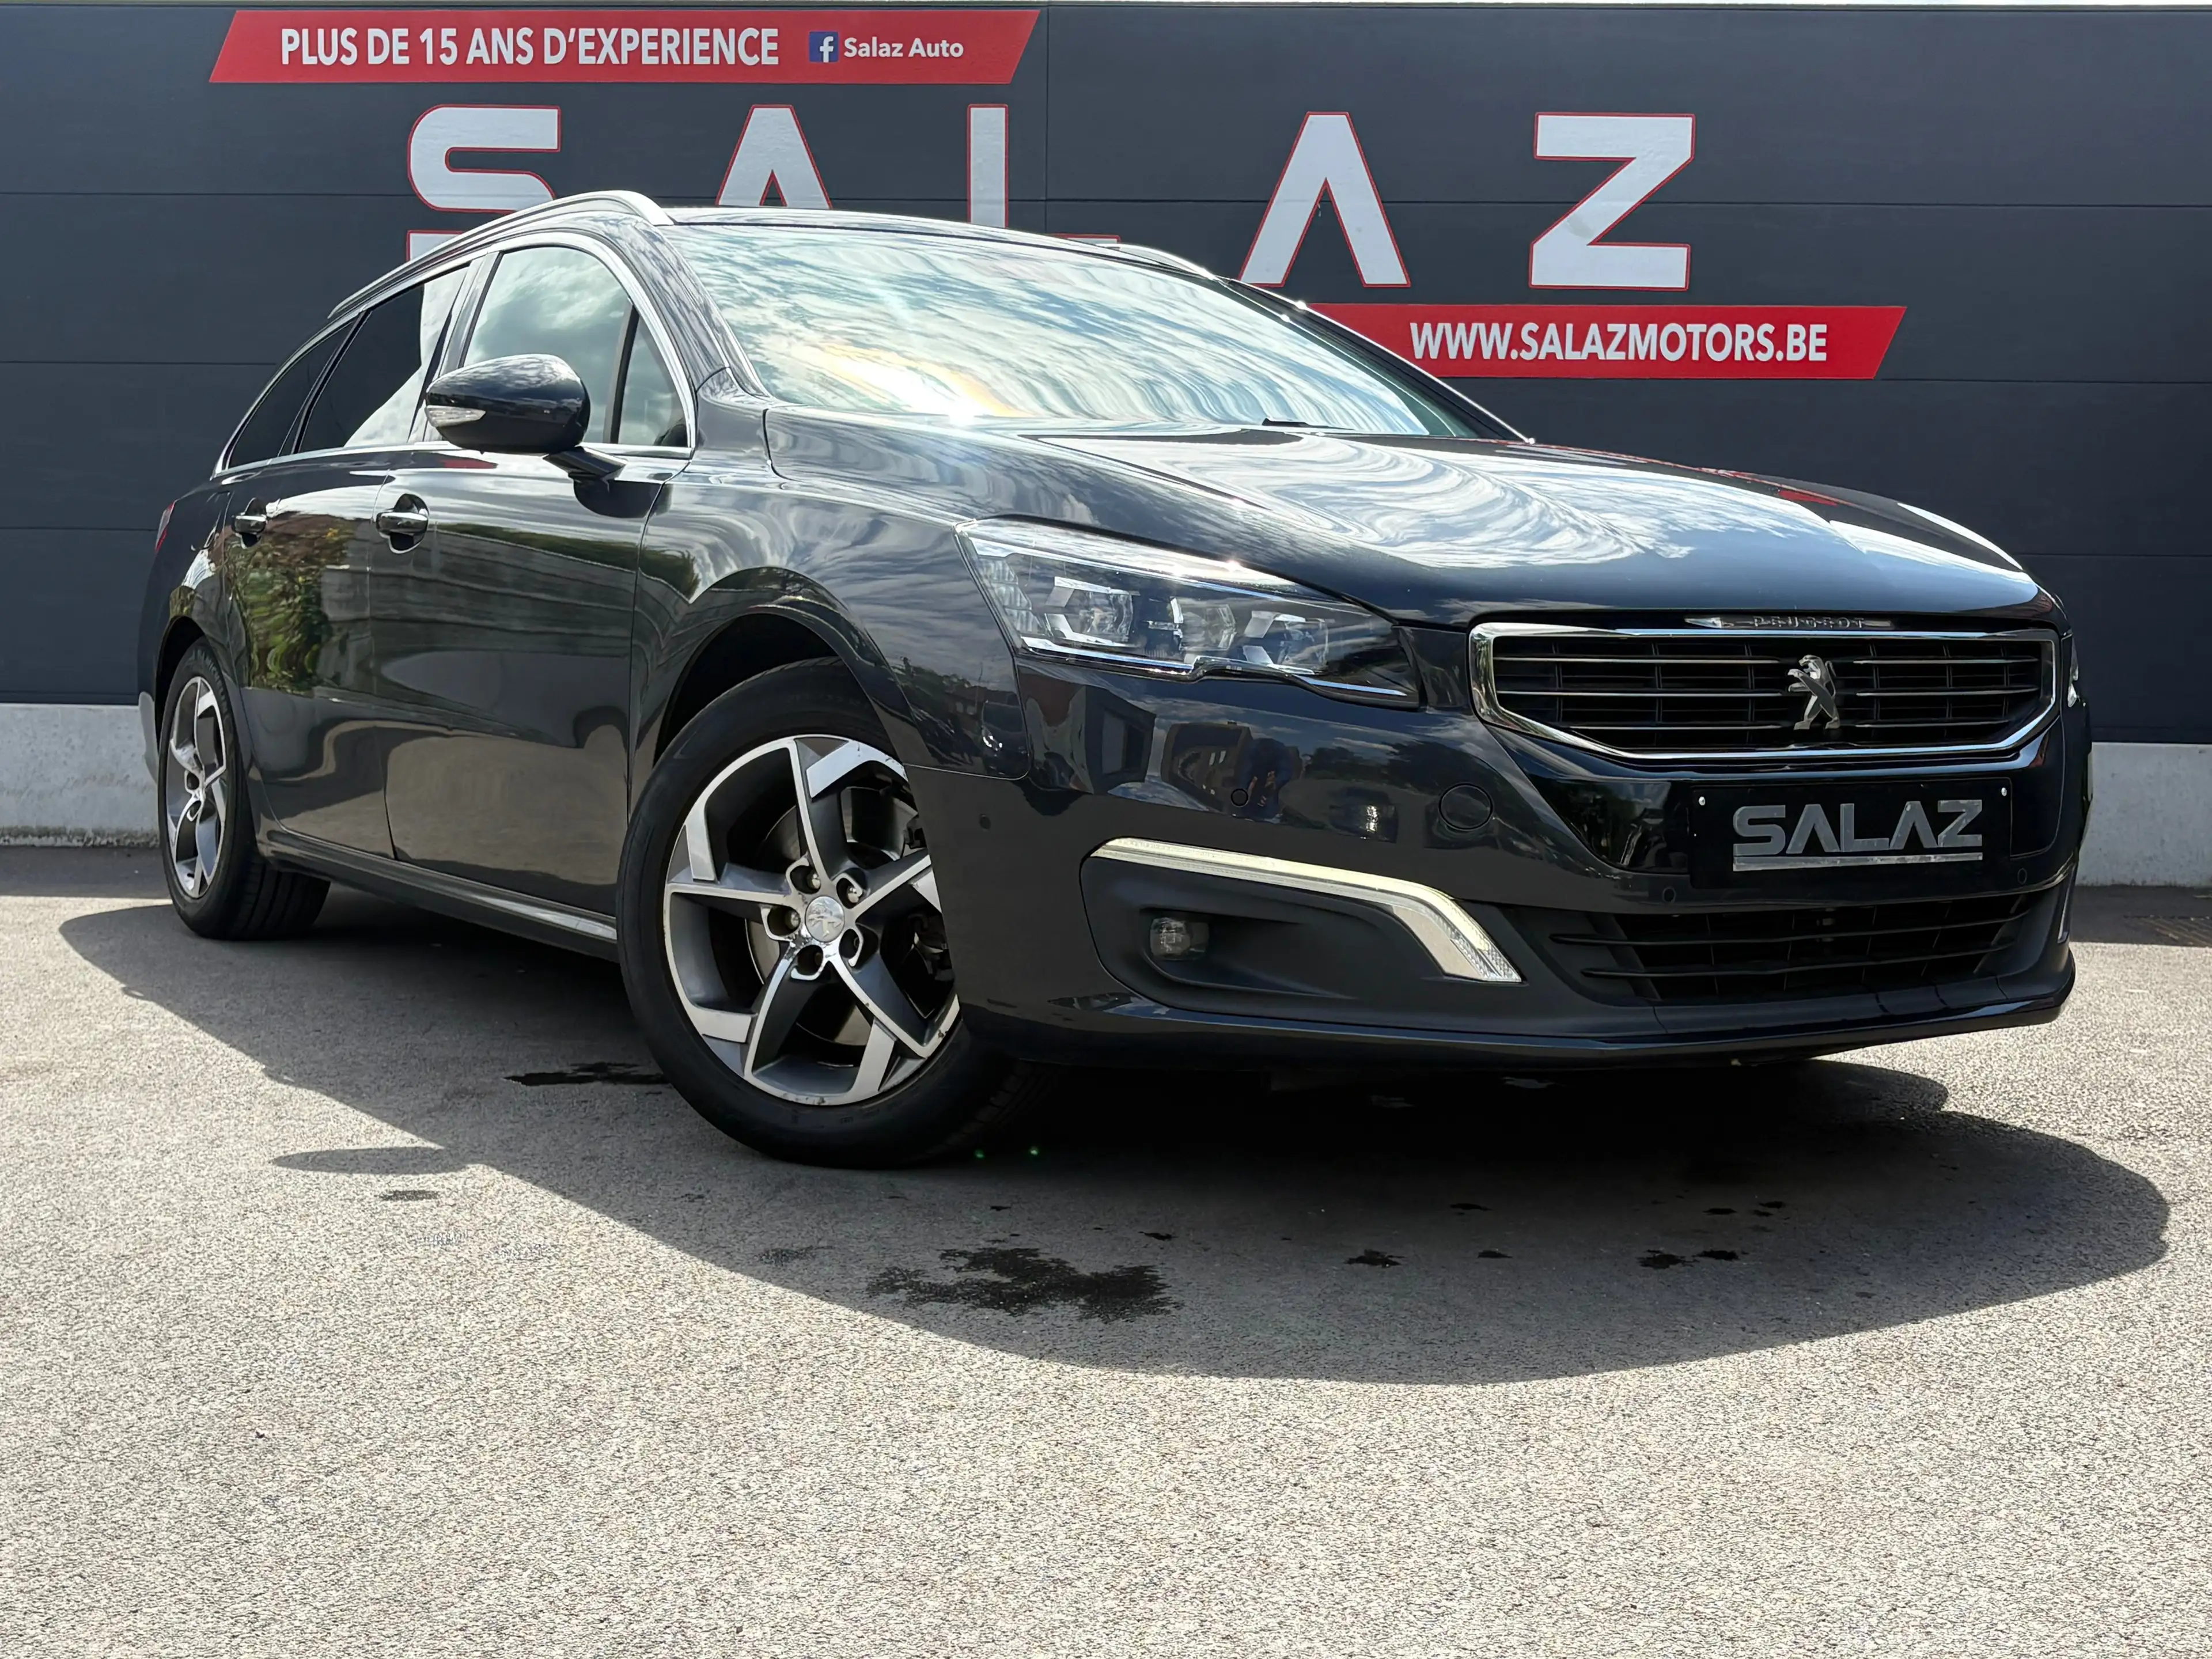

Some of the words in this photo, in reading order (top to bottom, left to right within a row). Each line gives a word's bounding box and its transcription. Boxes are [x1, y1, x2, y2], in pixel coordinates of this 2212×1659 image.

[281, 28, 358, 66] PLUS
[367, 28, 410, 65] DE
[419, 28, 458, 66] 15
[465, 28, 534, 65] ANS
[544, 27, 779, 66] D'EXPERIENCE
[844, 36, 904, 58] Salaz
[908, 37, 964, 58] Auto
[1410, 323, 1827, 362] WWW.SALAZMOTORS.BE
[1733, 800, 1982, 855] SALAZ
